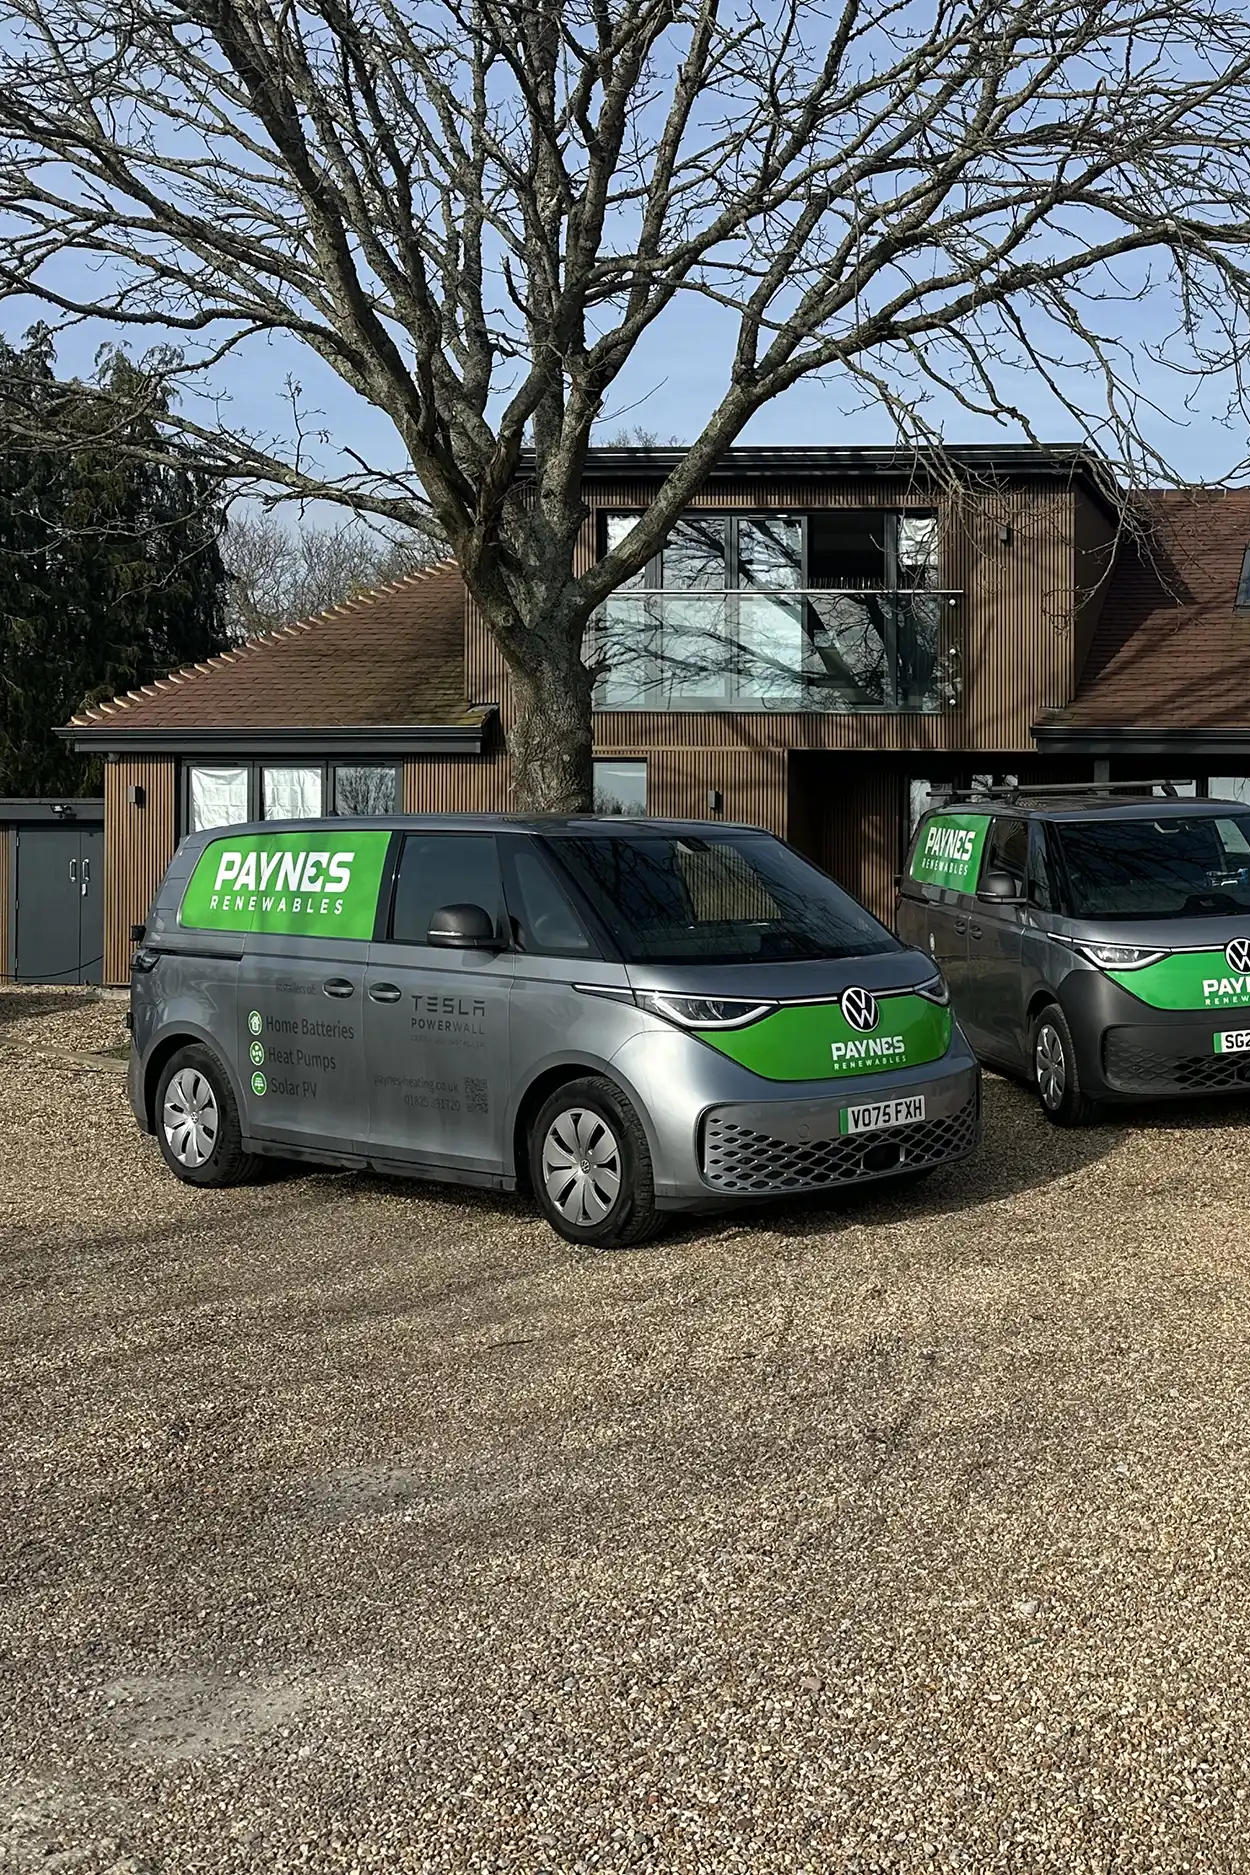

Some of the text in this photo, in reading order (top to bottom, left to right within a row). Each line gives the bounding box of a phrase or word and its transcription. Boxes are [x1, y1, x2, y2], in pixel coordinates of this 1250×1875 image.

[925, 827, 976, 861] PAYNES
[214, 851, 355, 892] PAYNES
[921, 858, 969, 875] RENEWABLES
[210, 896, 344, 915] RENEWABLES
[411, 995, 485, 1016] TESLA
[266, 1016, 355, 1039] Home Batteries
[411, 1018, 485, 1035] POWERWALL
[268, 1047, 336, 1071] Heat Pumps
[831, 1036, 905, 1061] PAYNES
[834, 1056, 907, 1070] RENEWABLES
[271, 1077, 317, 1098] Solar PV
[852, 1099, 922, 1129] VO75 FXH
